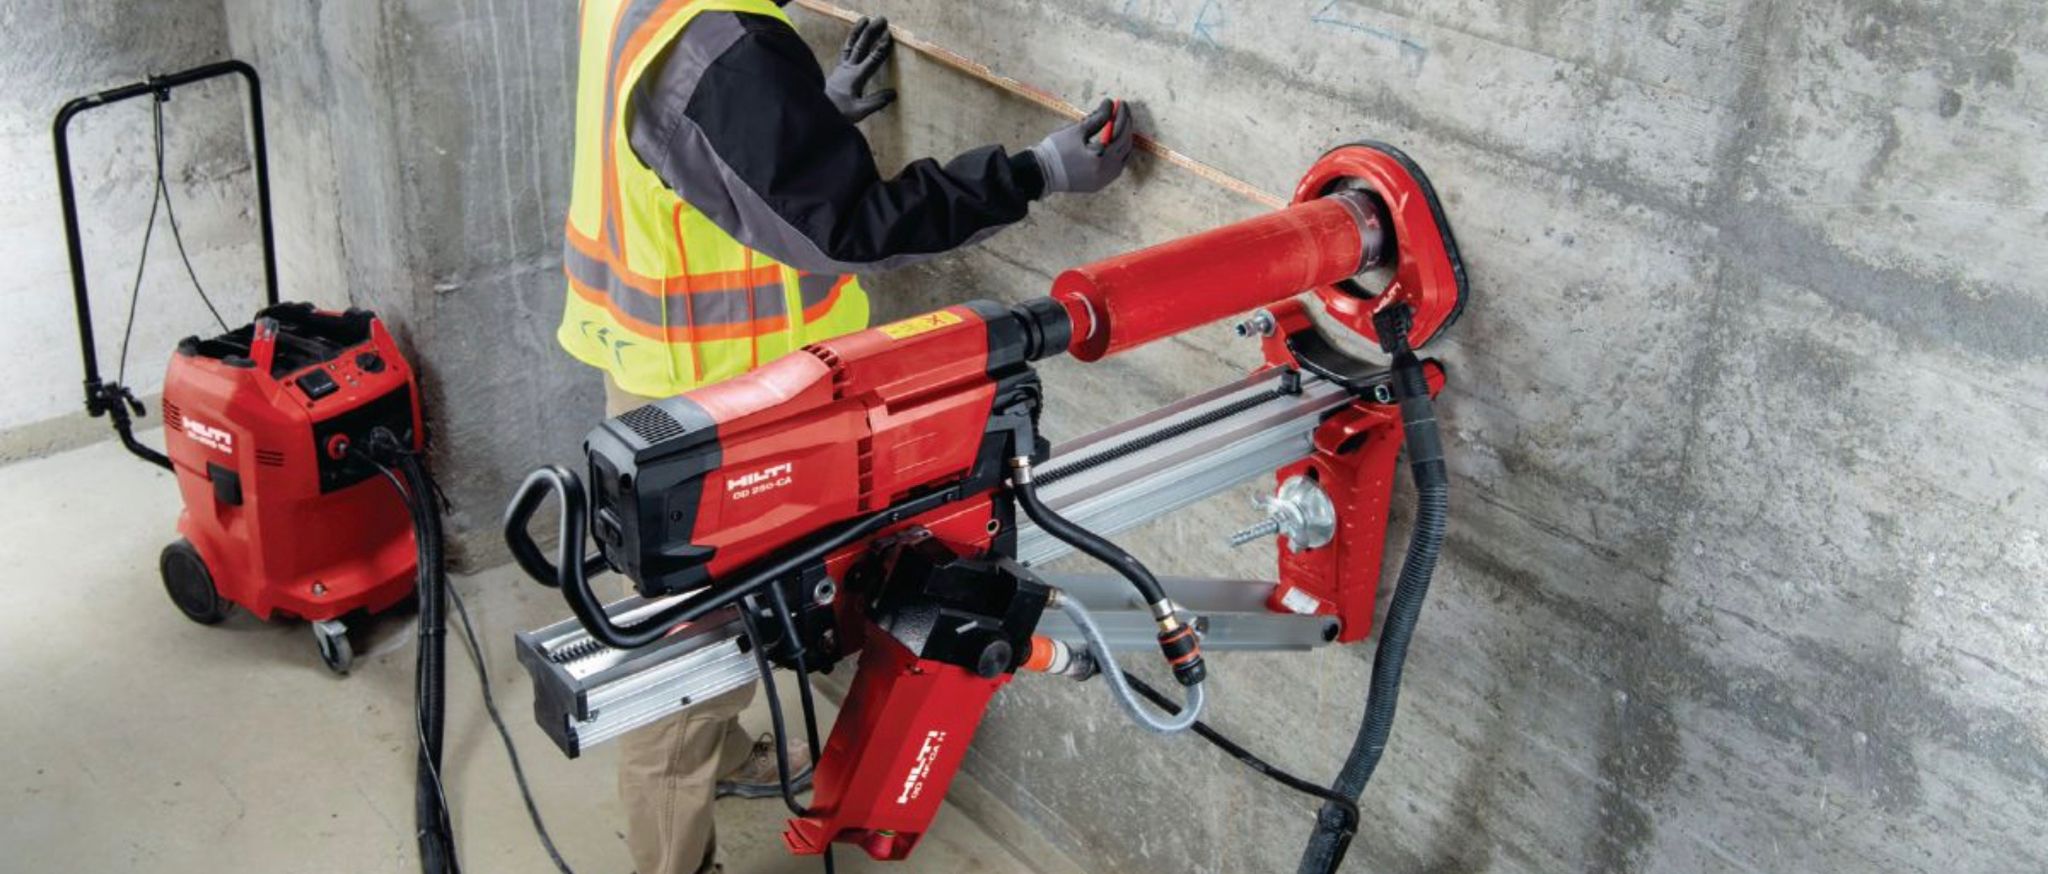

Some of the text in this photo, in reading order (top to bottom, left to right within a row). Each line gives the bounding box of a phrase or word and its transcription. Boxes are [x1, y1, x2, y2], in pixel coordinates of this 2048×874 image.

[182, 416, 232, 445] HILTI
[727, 462, 792, 491] HILTI
[752, 476, 792, 494] 250-CA
[896, 731, 939, 804] HILTI
